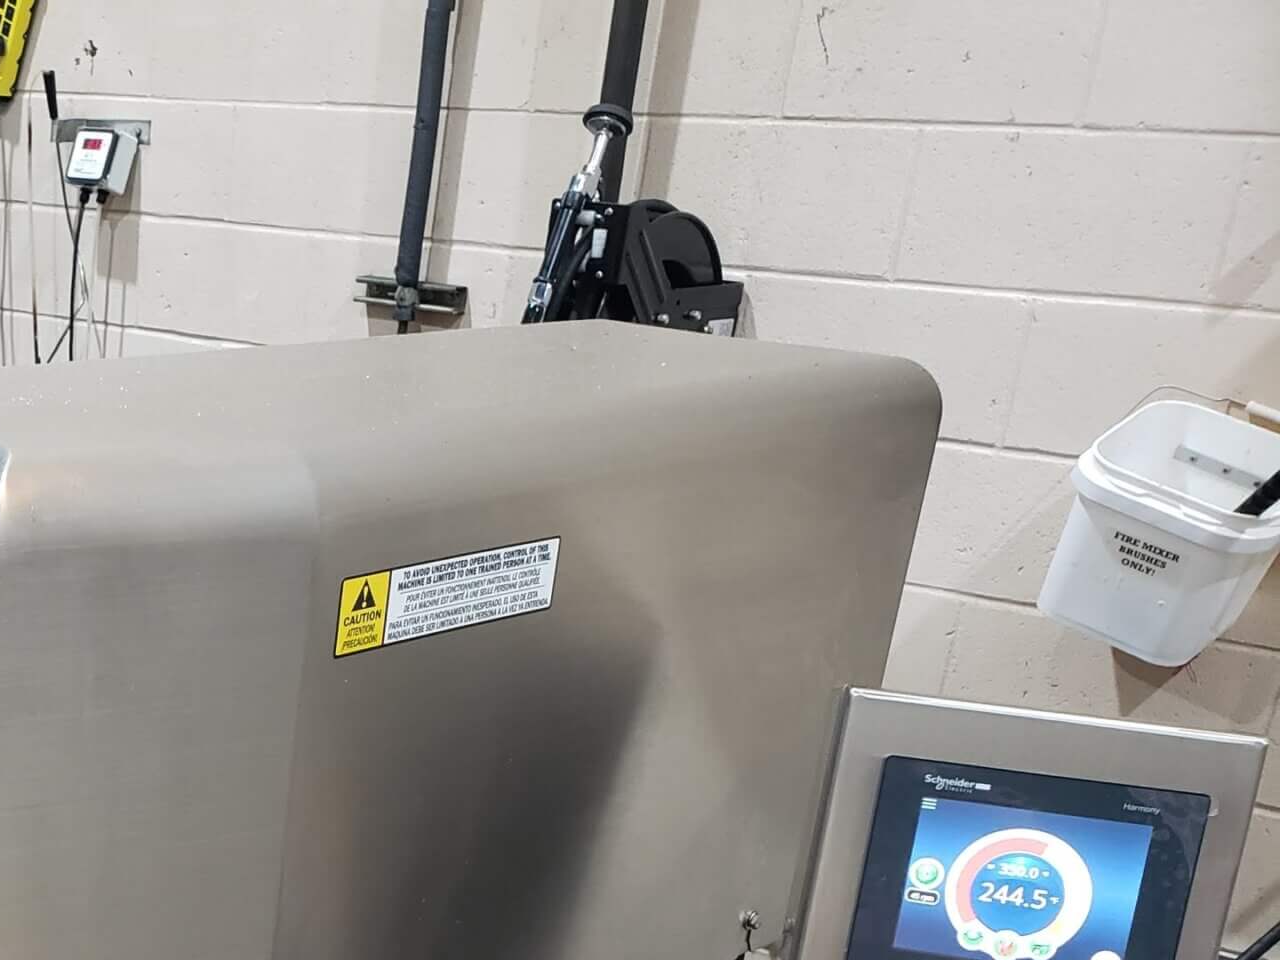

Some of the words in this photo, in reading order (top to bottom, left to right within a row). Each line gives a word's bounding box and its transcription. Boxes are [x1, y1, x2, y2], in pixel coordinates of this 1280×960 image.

[1114, 531, 1141, 547] FIRE
[1142, 542, 1180, 563] MIXER
[1119, 545, 1167, 569] BRUSHES
[431, 559, 468, 574] UNEXPECTED
[503, 547, 528, 560] CONTROL
[1121, 558, 1155, 576] ONLY!
[397, 577, 425, 591] MACHINE
[477, 561, 501, 574] TRAINED
[502, 556, 524, 569] PERSON
[344, 609, 382, 627] CAUTION
[924, 774, 976, 790] Schneider
[1122, 802, 1161, 816] Harmony
[978, 882, 1048, 910] 244.5
